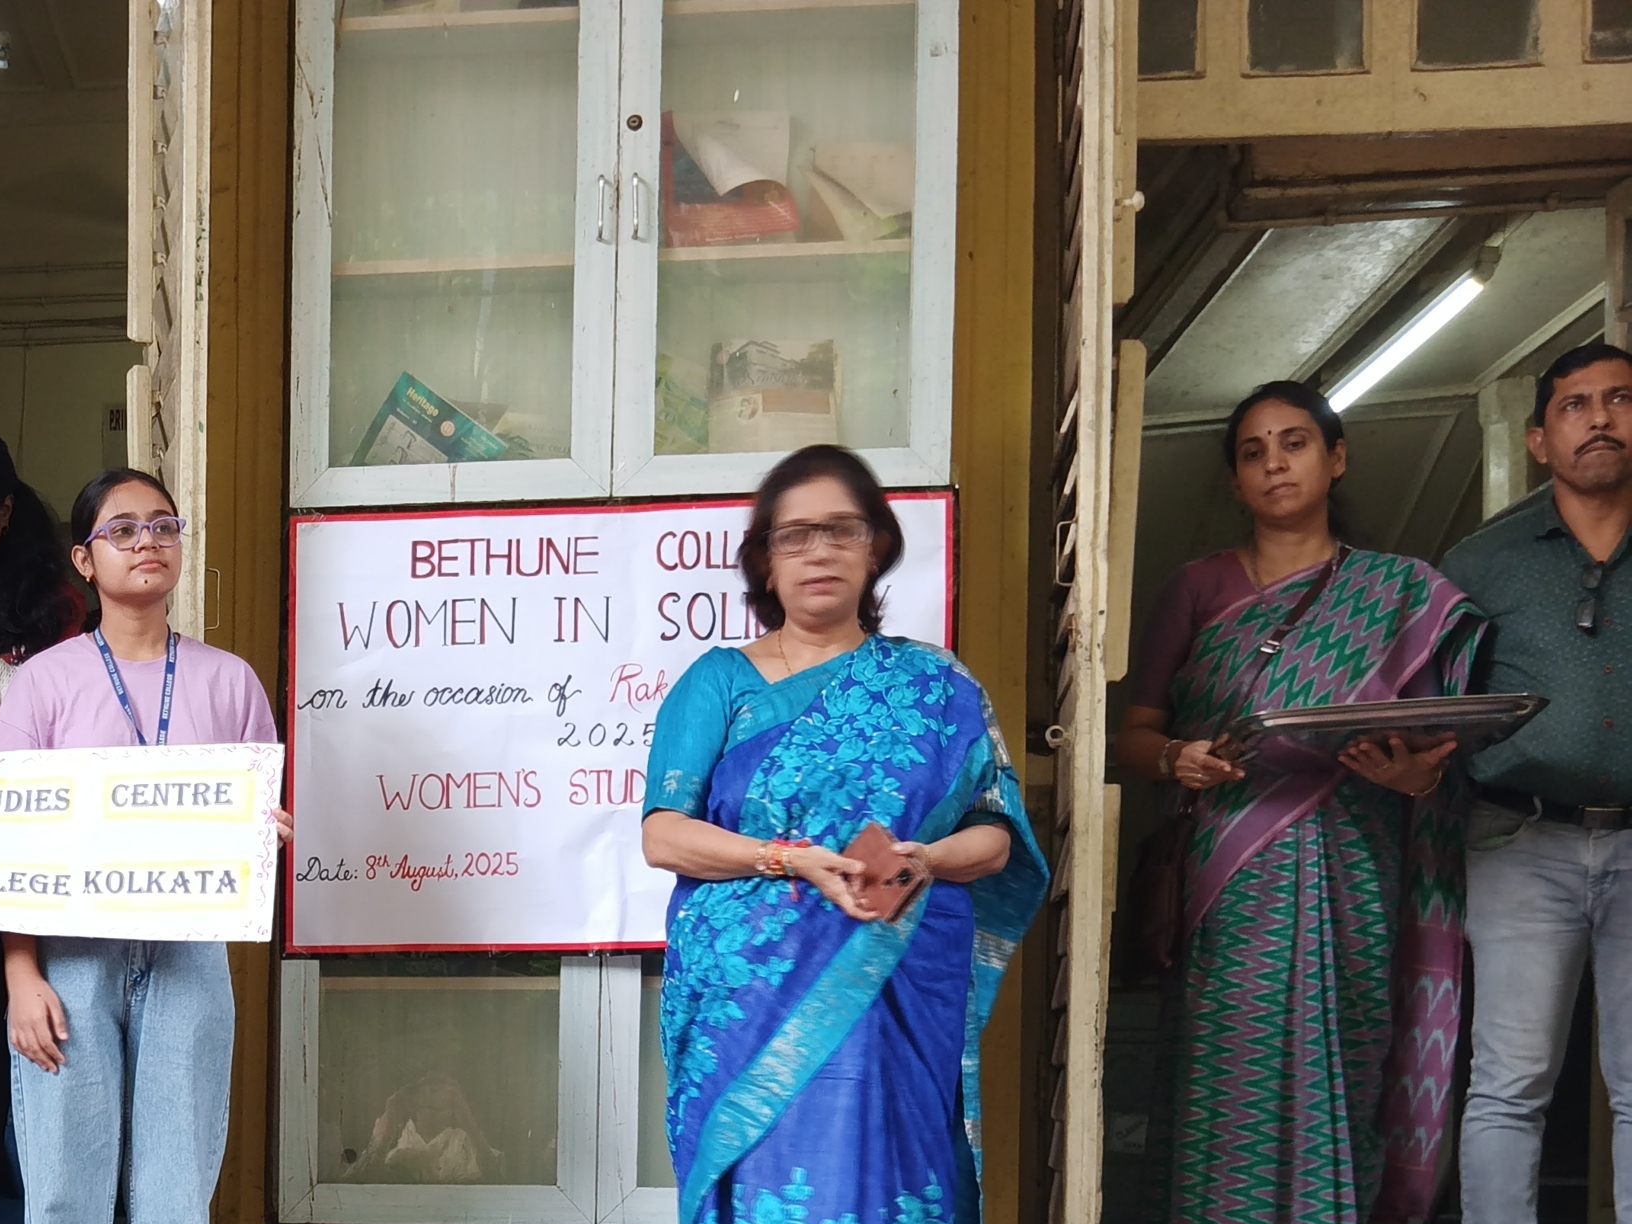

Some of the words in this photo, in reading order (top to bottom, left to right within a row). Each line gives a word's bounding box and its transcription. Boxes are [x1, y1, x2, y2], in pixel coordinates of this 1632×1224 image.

[411, 536, 599, 578] BETHUNE
[656, 530, 750, 571] COLL
[337, 596, 517, 650] WOMEN
[553, 596, 612, 643] IN
[297, 688, 347, 710] on
[362, 679, 415, 709] the
[423, 683, 533, 707] occasion
[548, 675, 582, 717] of
[111, 781, 234, 808] CENTRE
[376, 769, 541, 810] WOMEN'S
[83, 869, 239, 895] KOLKATA
[296, 856, 358, 882] Date:
[365, 855, 390, 880] 8th
[390, 854, 458, 892] August,
[462, 852, 519, 877] 2025
